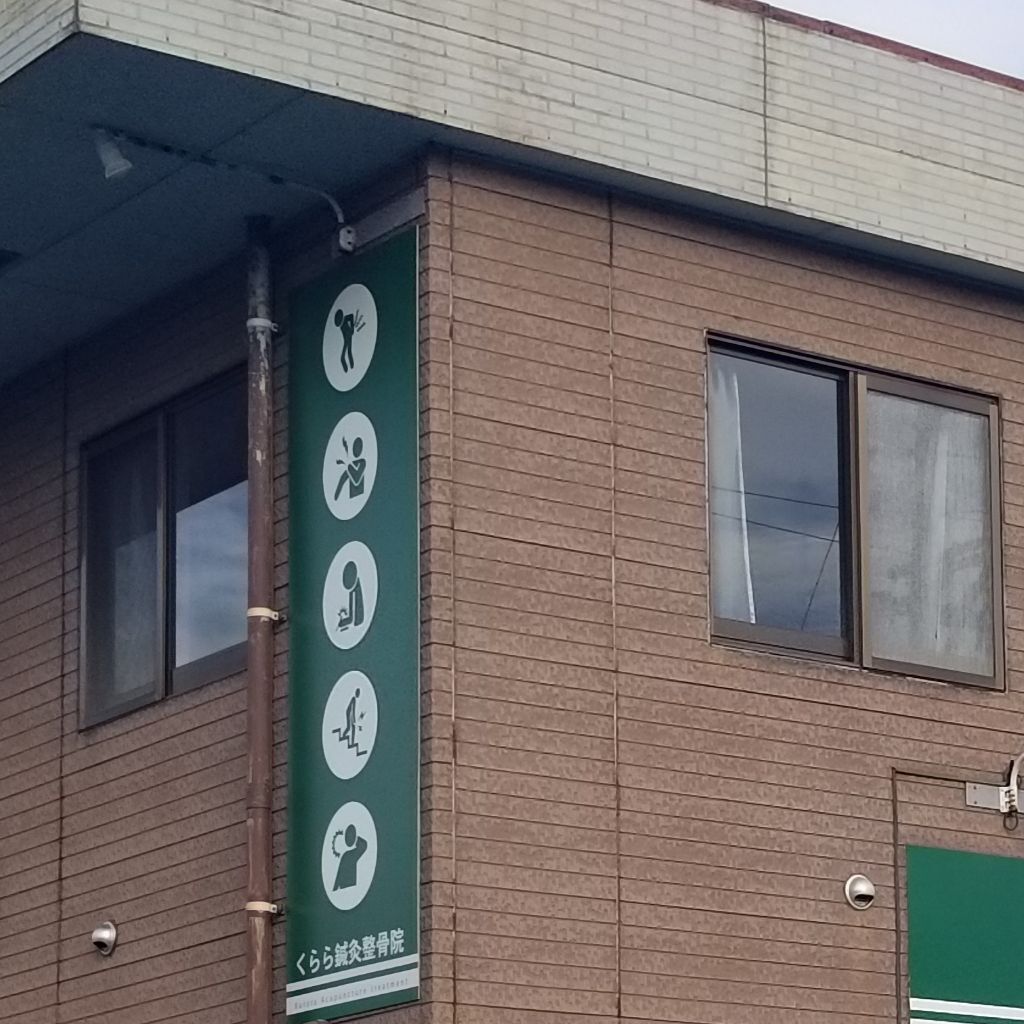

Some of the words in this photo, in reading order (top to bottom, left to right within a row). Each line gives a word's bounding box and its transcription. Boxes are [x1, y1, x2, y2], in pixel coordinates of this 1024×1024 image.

[296, 928, 404, 976] くらら鍼灸整骨院
